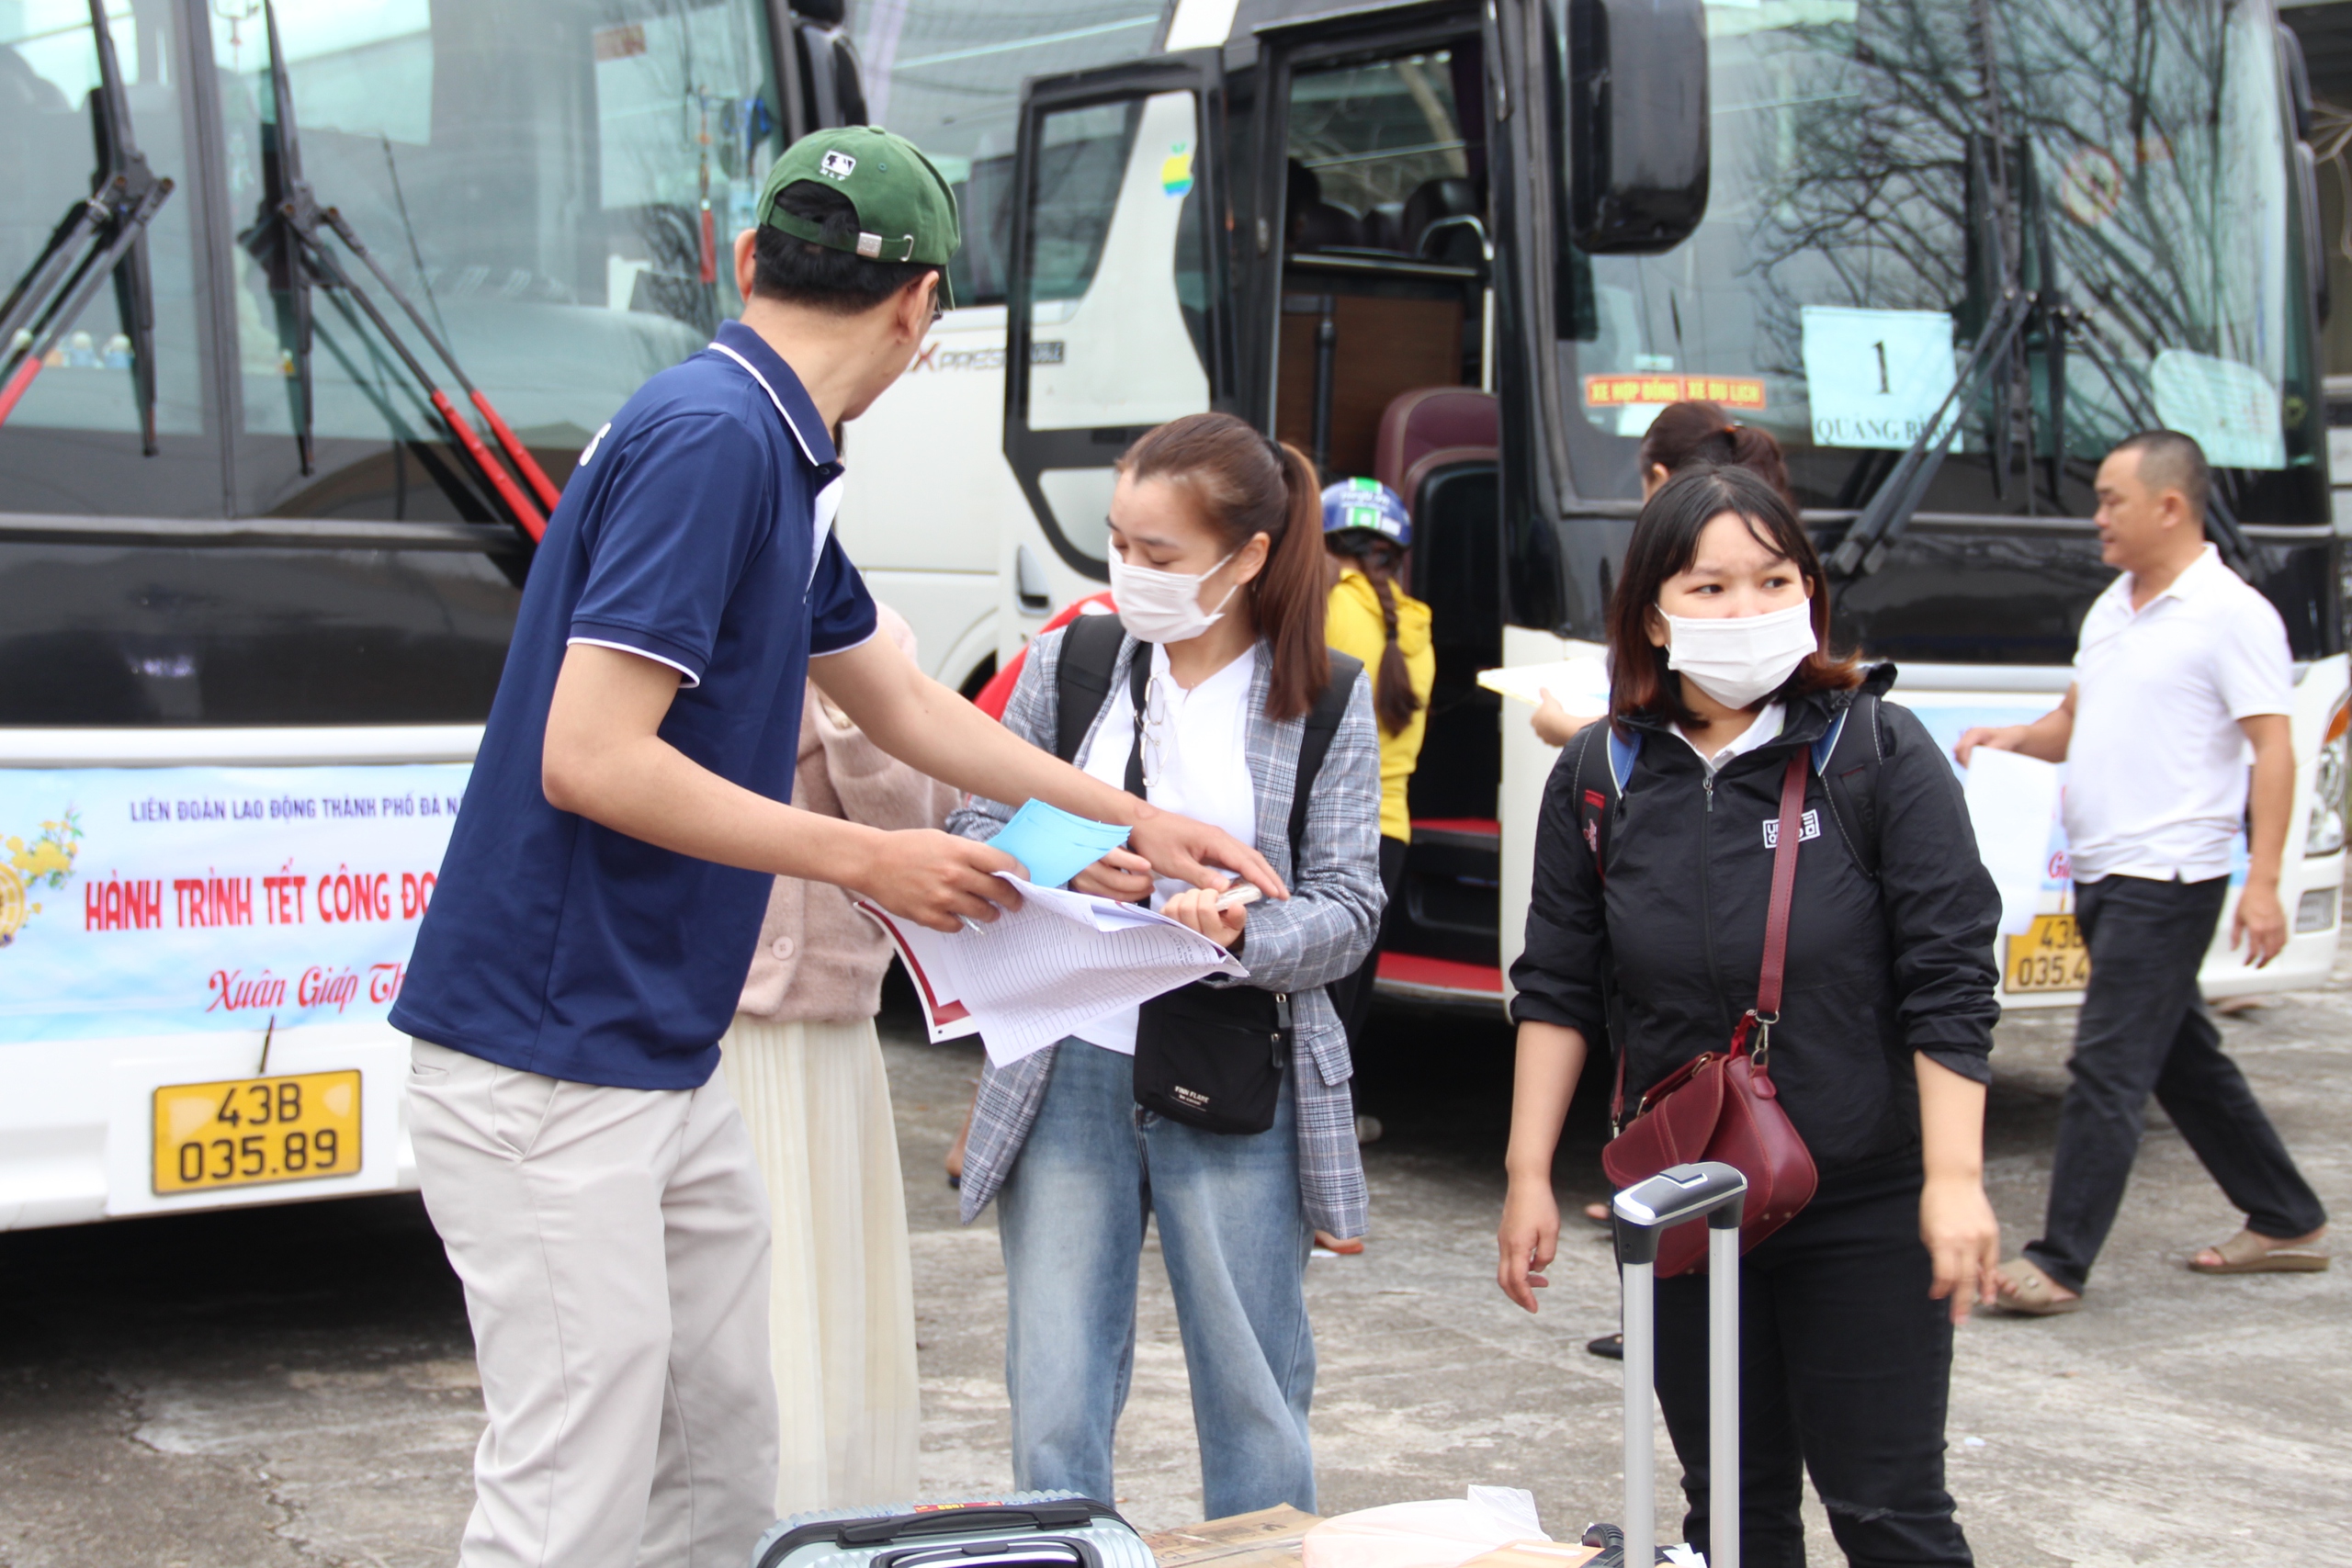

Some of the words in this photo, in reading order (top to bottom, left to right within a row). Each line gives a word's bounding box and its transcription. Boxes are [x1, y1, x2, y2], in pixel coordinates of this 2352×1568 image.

[1870, 340, 1890, 395] 1
[177, 795, 226, 821] ĐOÀN
[232, 798, 264, 820] LAO
[270, 795, 316, 825] ĐỘNG
[322, 793, 376, 818] THÀNH
[382, 789, 414, 818] PHỐ
[420, 793, 442, 818] ĐÀ
[85, 869, 162, 931] HÀNH
[173, 866, 254, 928] TRÌNH
[263, 856, 307, 924] TẾT
[317, 862, 390, 923] CÔNG
[401, 870, 437, 920] ĐO
[205, 968, 288, 1012] Xuân
[298, 965, 359, 1014] Giáp
[369, 963, 405, 1004] Th
[2018, 955, 2087, 987] 035.4
[217, 1082, 301, 1128] 43B
[179, 1128, 338, 1181] 035.89
